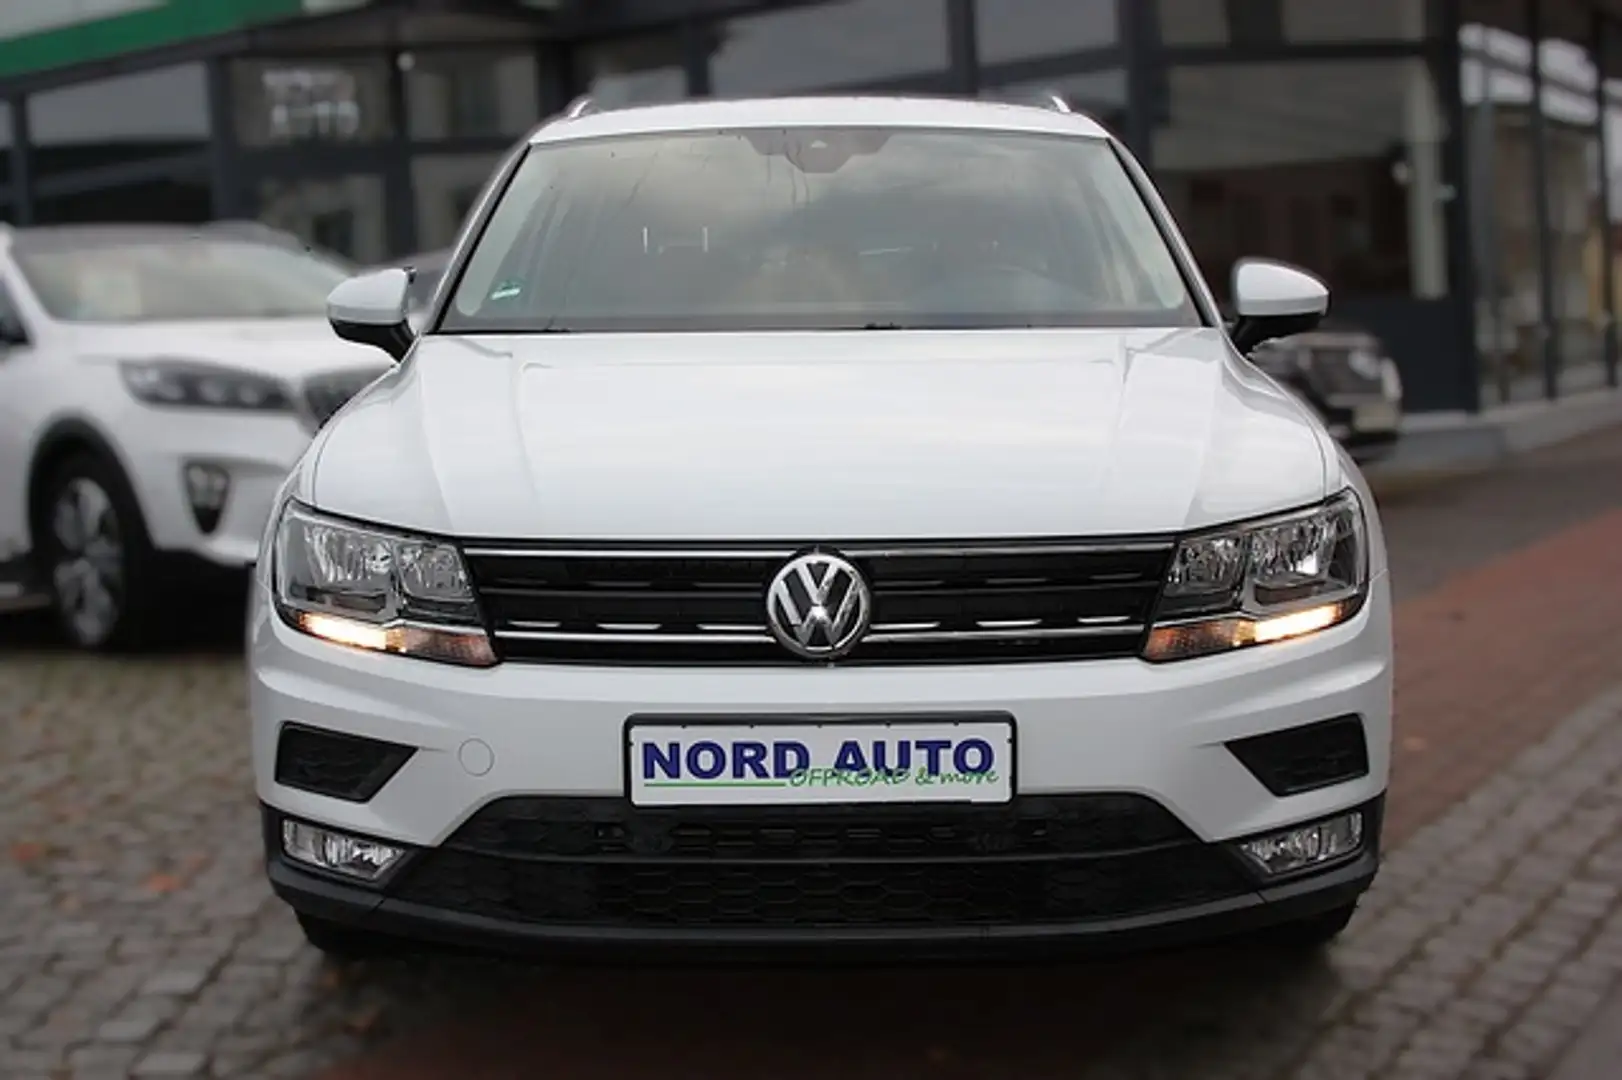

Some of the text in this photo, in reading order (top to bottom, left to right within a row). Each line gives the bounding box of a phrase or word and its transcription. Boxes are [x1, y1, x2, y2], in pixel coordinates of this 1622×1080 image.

[768, 555, 867, 655] VW
[642, 738, 995, 780] NORD AUTO
[915, 765, 935, 786] &
[940, 769, 1000, 786] more
